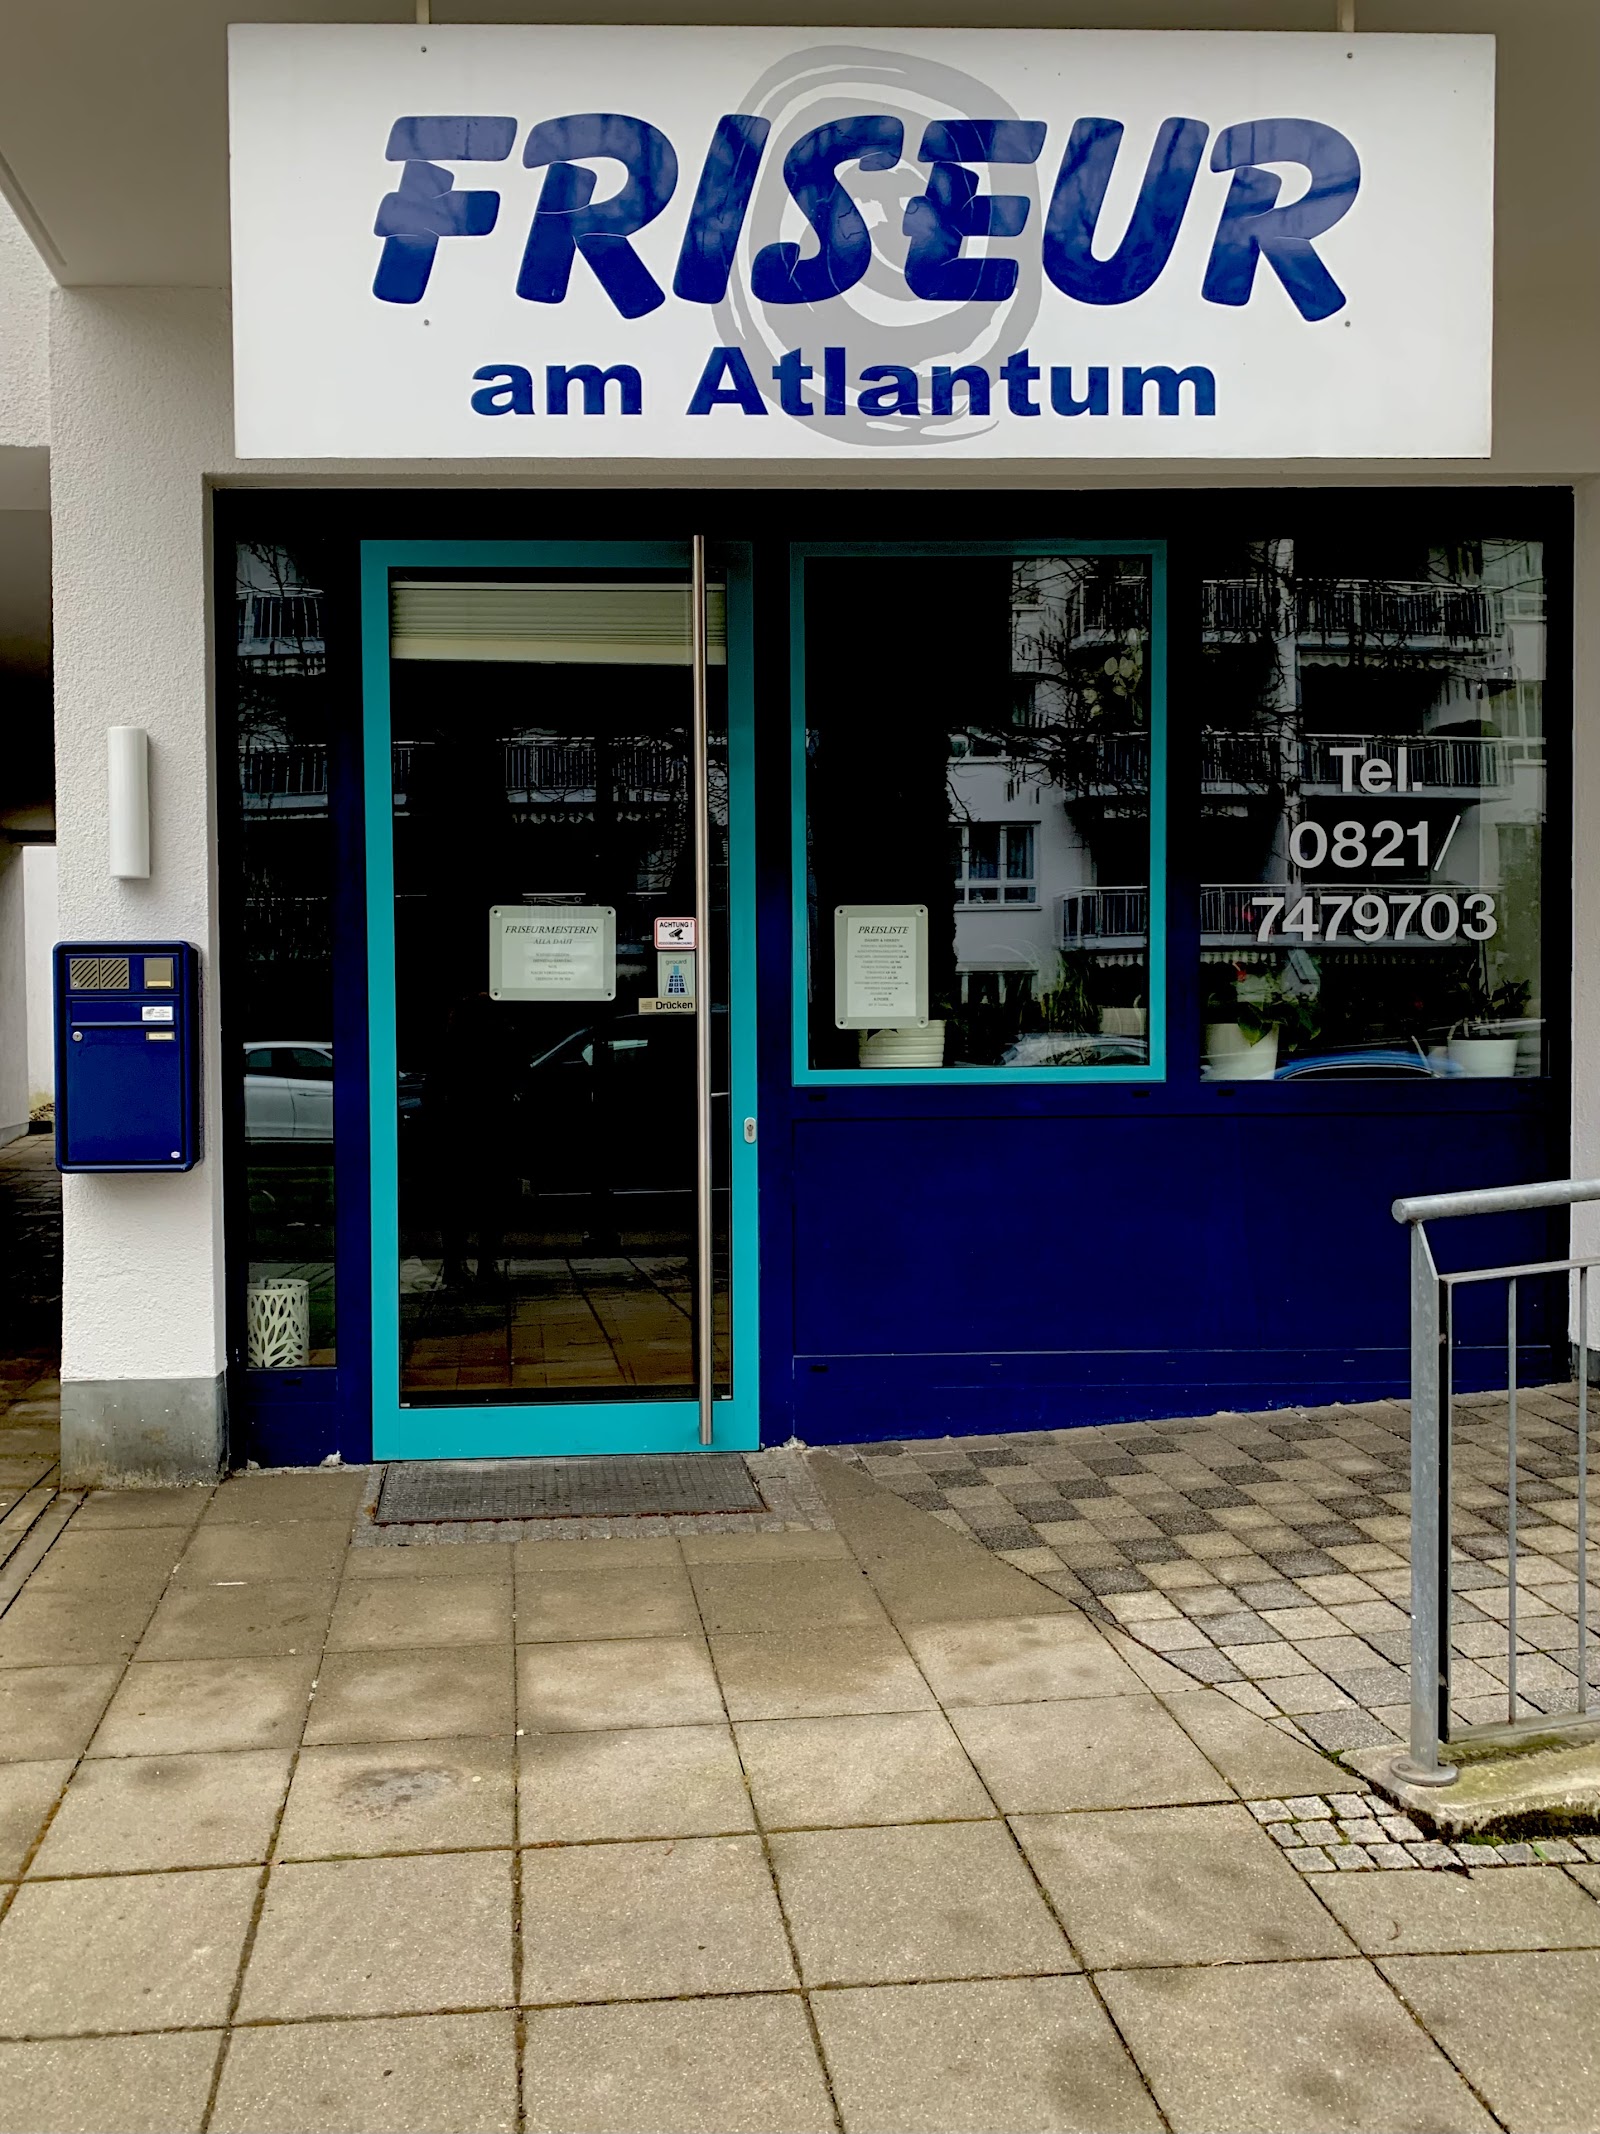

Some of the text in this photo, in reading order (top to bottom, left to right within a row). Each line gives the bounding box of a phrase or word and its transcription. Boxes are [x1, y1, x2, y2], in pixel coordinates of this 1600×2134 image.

[374, 114, 1360, 321] FRISEUR
[471, 347, 1215, 416] am Atlantum
[1330, 746, 1423, 793] Tel.
[1289, 814, 1461, 872] 0821/
[505, 925, 599, 934] FRISEURMEISTERIN
[858, 926, 909, 934] PREISLISTE
[1252, 893, 1498, 942] 7479703
[655, 1001, 693, 1010] Drücken
